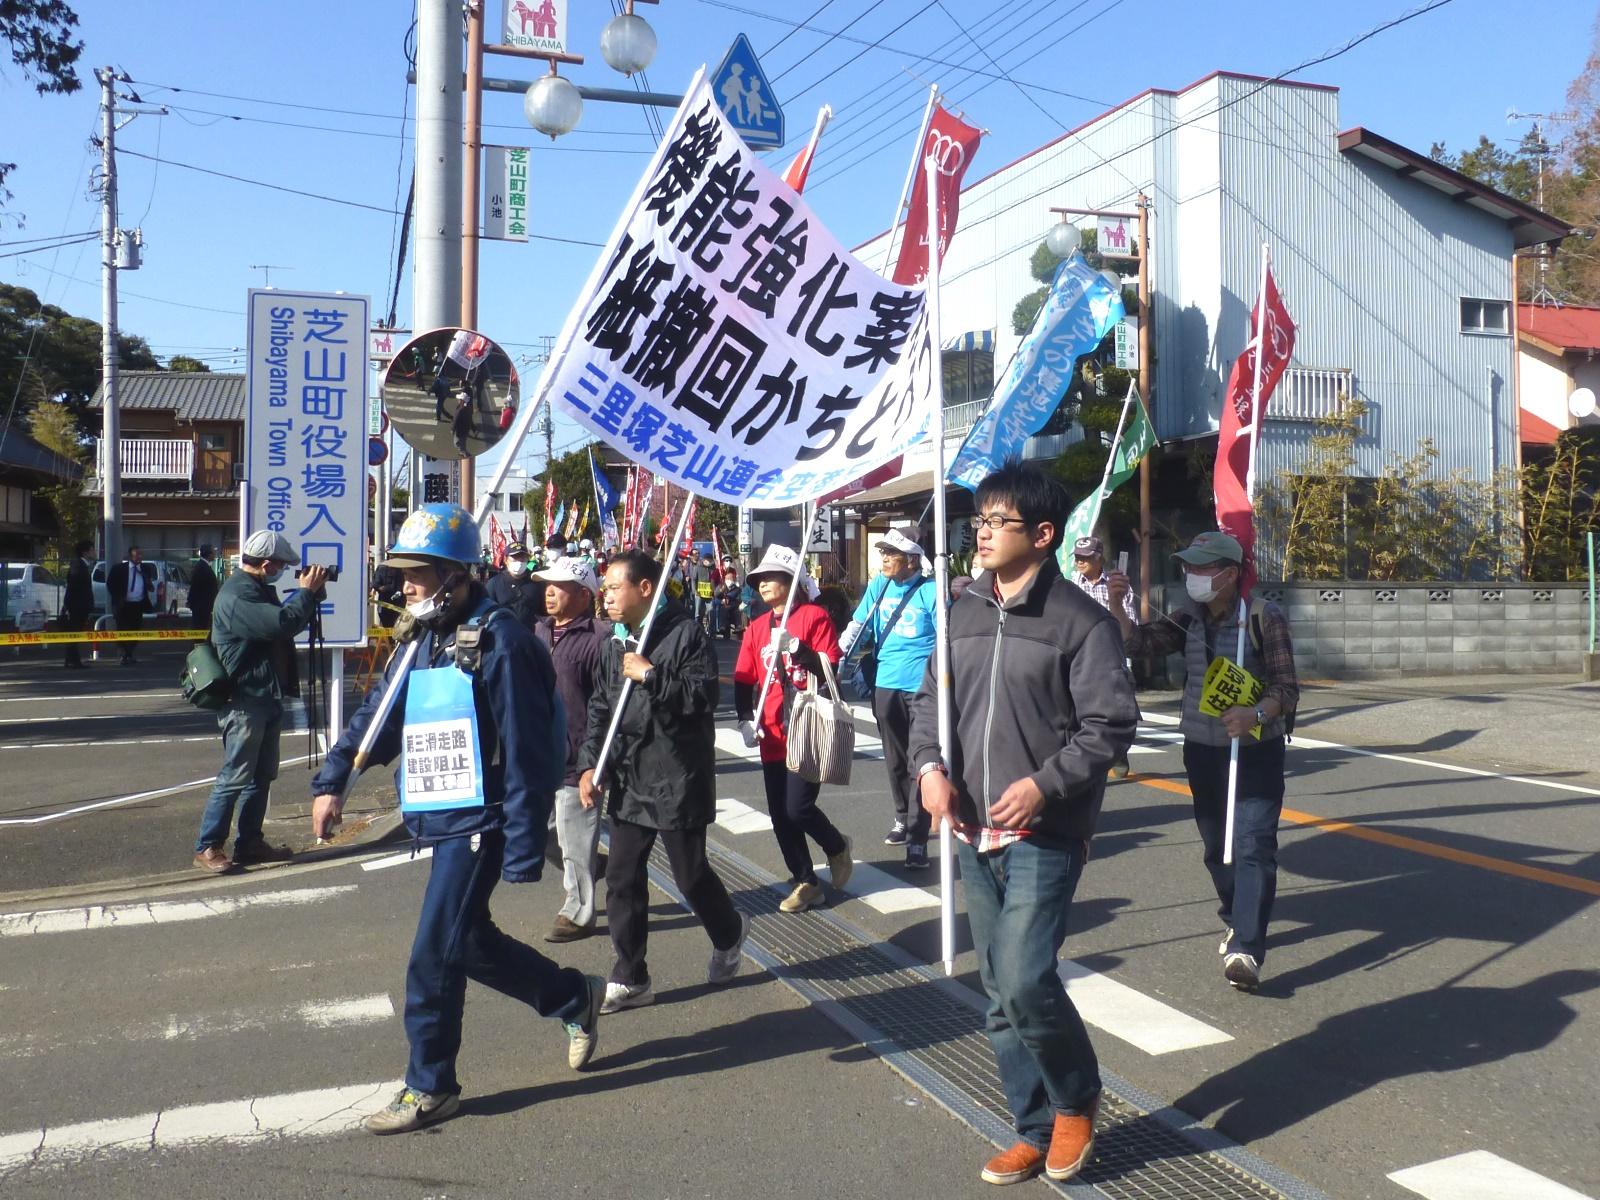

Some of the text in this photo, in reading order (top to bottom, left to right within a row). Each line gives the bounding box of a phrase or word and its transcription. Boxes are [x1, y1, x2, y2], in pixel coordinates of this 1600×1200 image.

[505, 34, 564, 50] SHIBAYAMA
[508, 149, 528, 236] 芝山町商工会
[491, 193, 503, 219] 小池
[265, 306, 296, 532] Shibayama Town Office
[299, 308, 349, 573] 芝山町役場入口
[406, 729, 467, 754] 第三滑走路
[407, 754, 470, 774] 建設阻止
